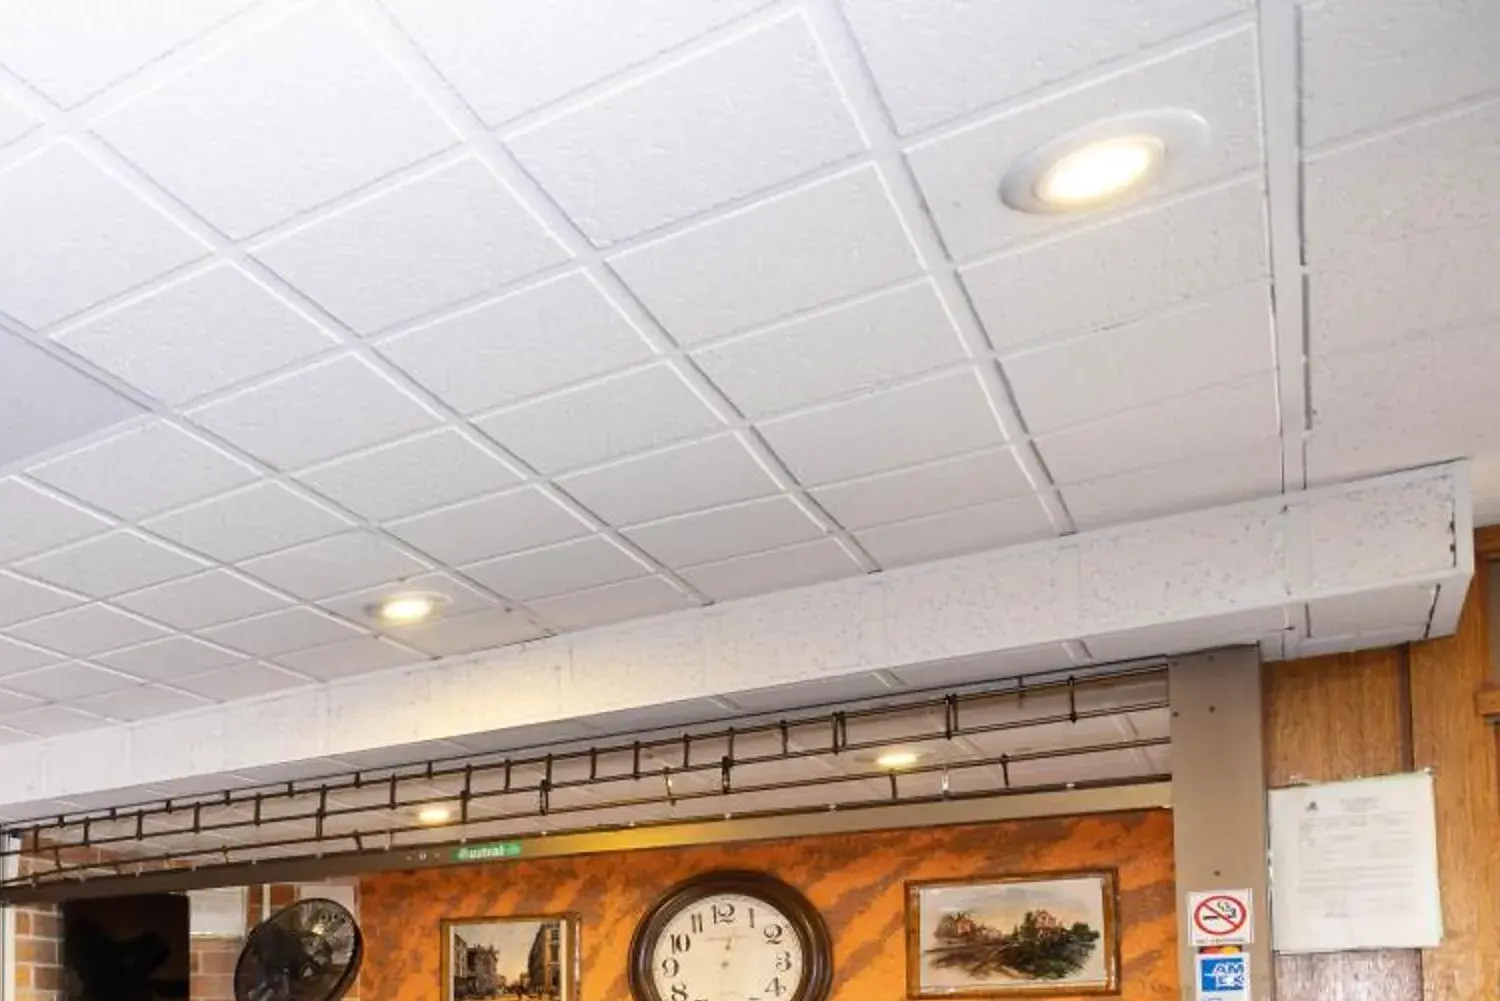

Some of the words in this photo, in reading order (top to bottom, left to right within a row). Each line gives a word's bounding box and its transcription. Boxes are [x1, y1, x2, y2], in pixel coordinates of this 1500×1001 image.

[690, 913, 703, 934] 11
[711, 902, 735, 925] 12
[748, 907, 755, 929] 1
[670, 933, 691, 955] 10
[763, 923, 783, 945] 2
[661, 957, 680, 978] 9
[775, 950, 792, 972] 3
[764, 976, 787, 997] 4
